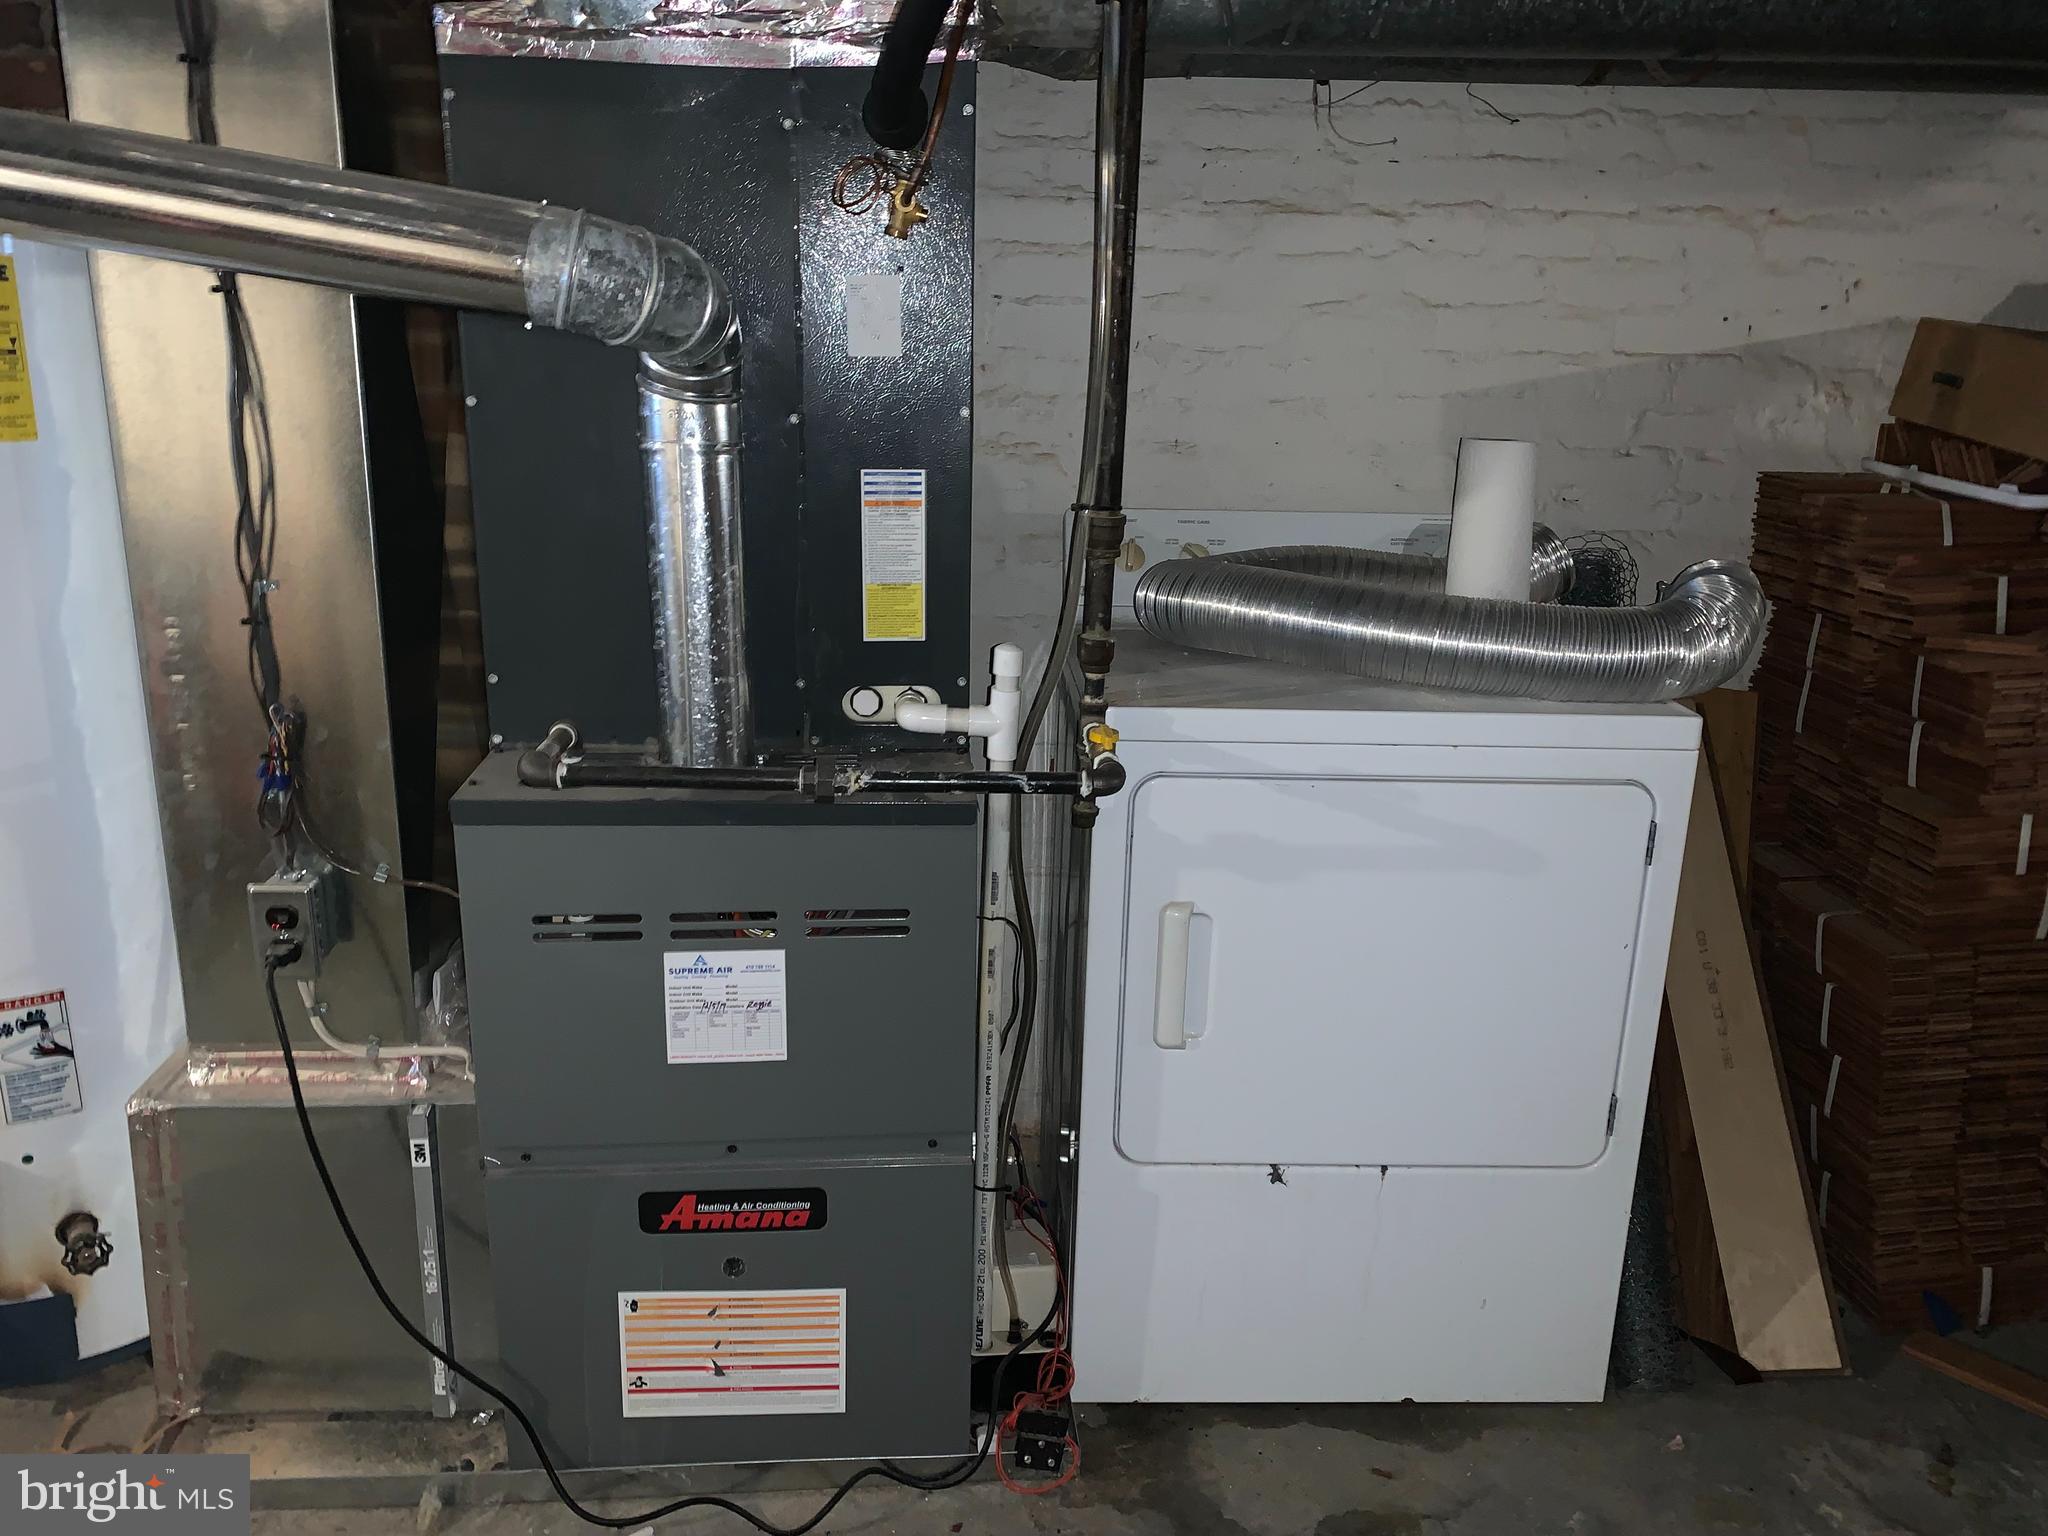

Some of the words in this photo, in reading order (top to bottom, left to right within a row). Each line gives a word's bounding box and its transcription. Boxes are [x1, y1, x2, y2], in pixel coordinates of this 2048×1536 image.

[669, 967, 714, 975] SUPREME
[716, 966, 733, 974] AIR
[413, 1143, 426, 1164] 3M
[659, 1194, 810, 1231] Amana
[698, 1202, 730, 1212] Heating
[732, 1202, 740, 1210] &
[742, 1201, 754, 1210] Air
[756, 1200, 811, 1210] Conditioning
[978, 1249, 986, 1265] 200
[977, 1275, 986, 1284] 21
[976, 1286, 984, 1302] SDR
